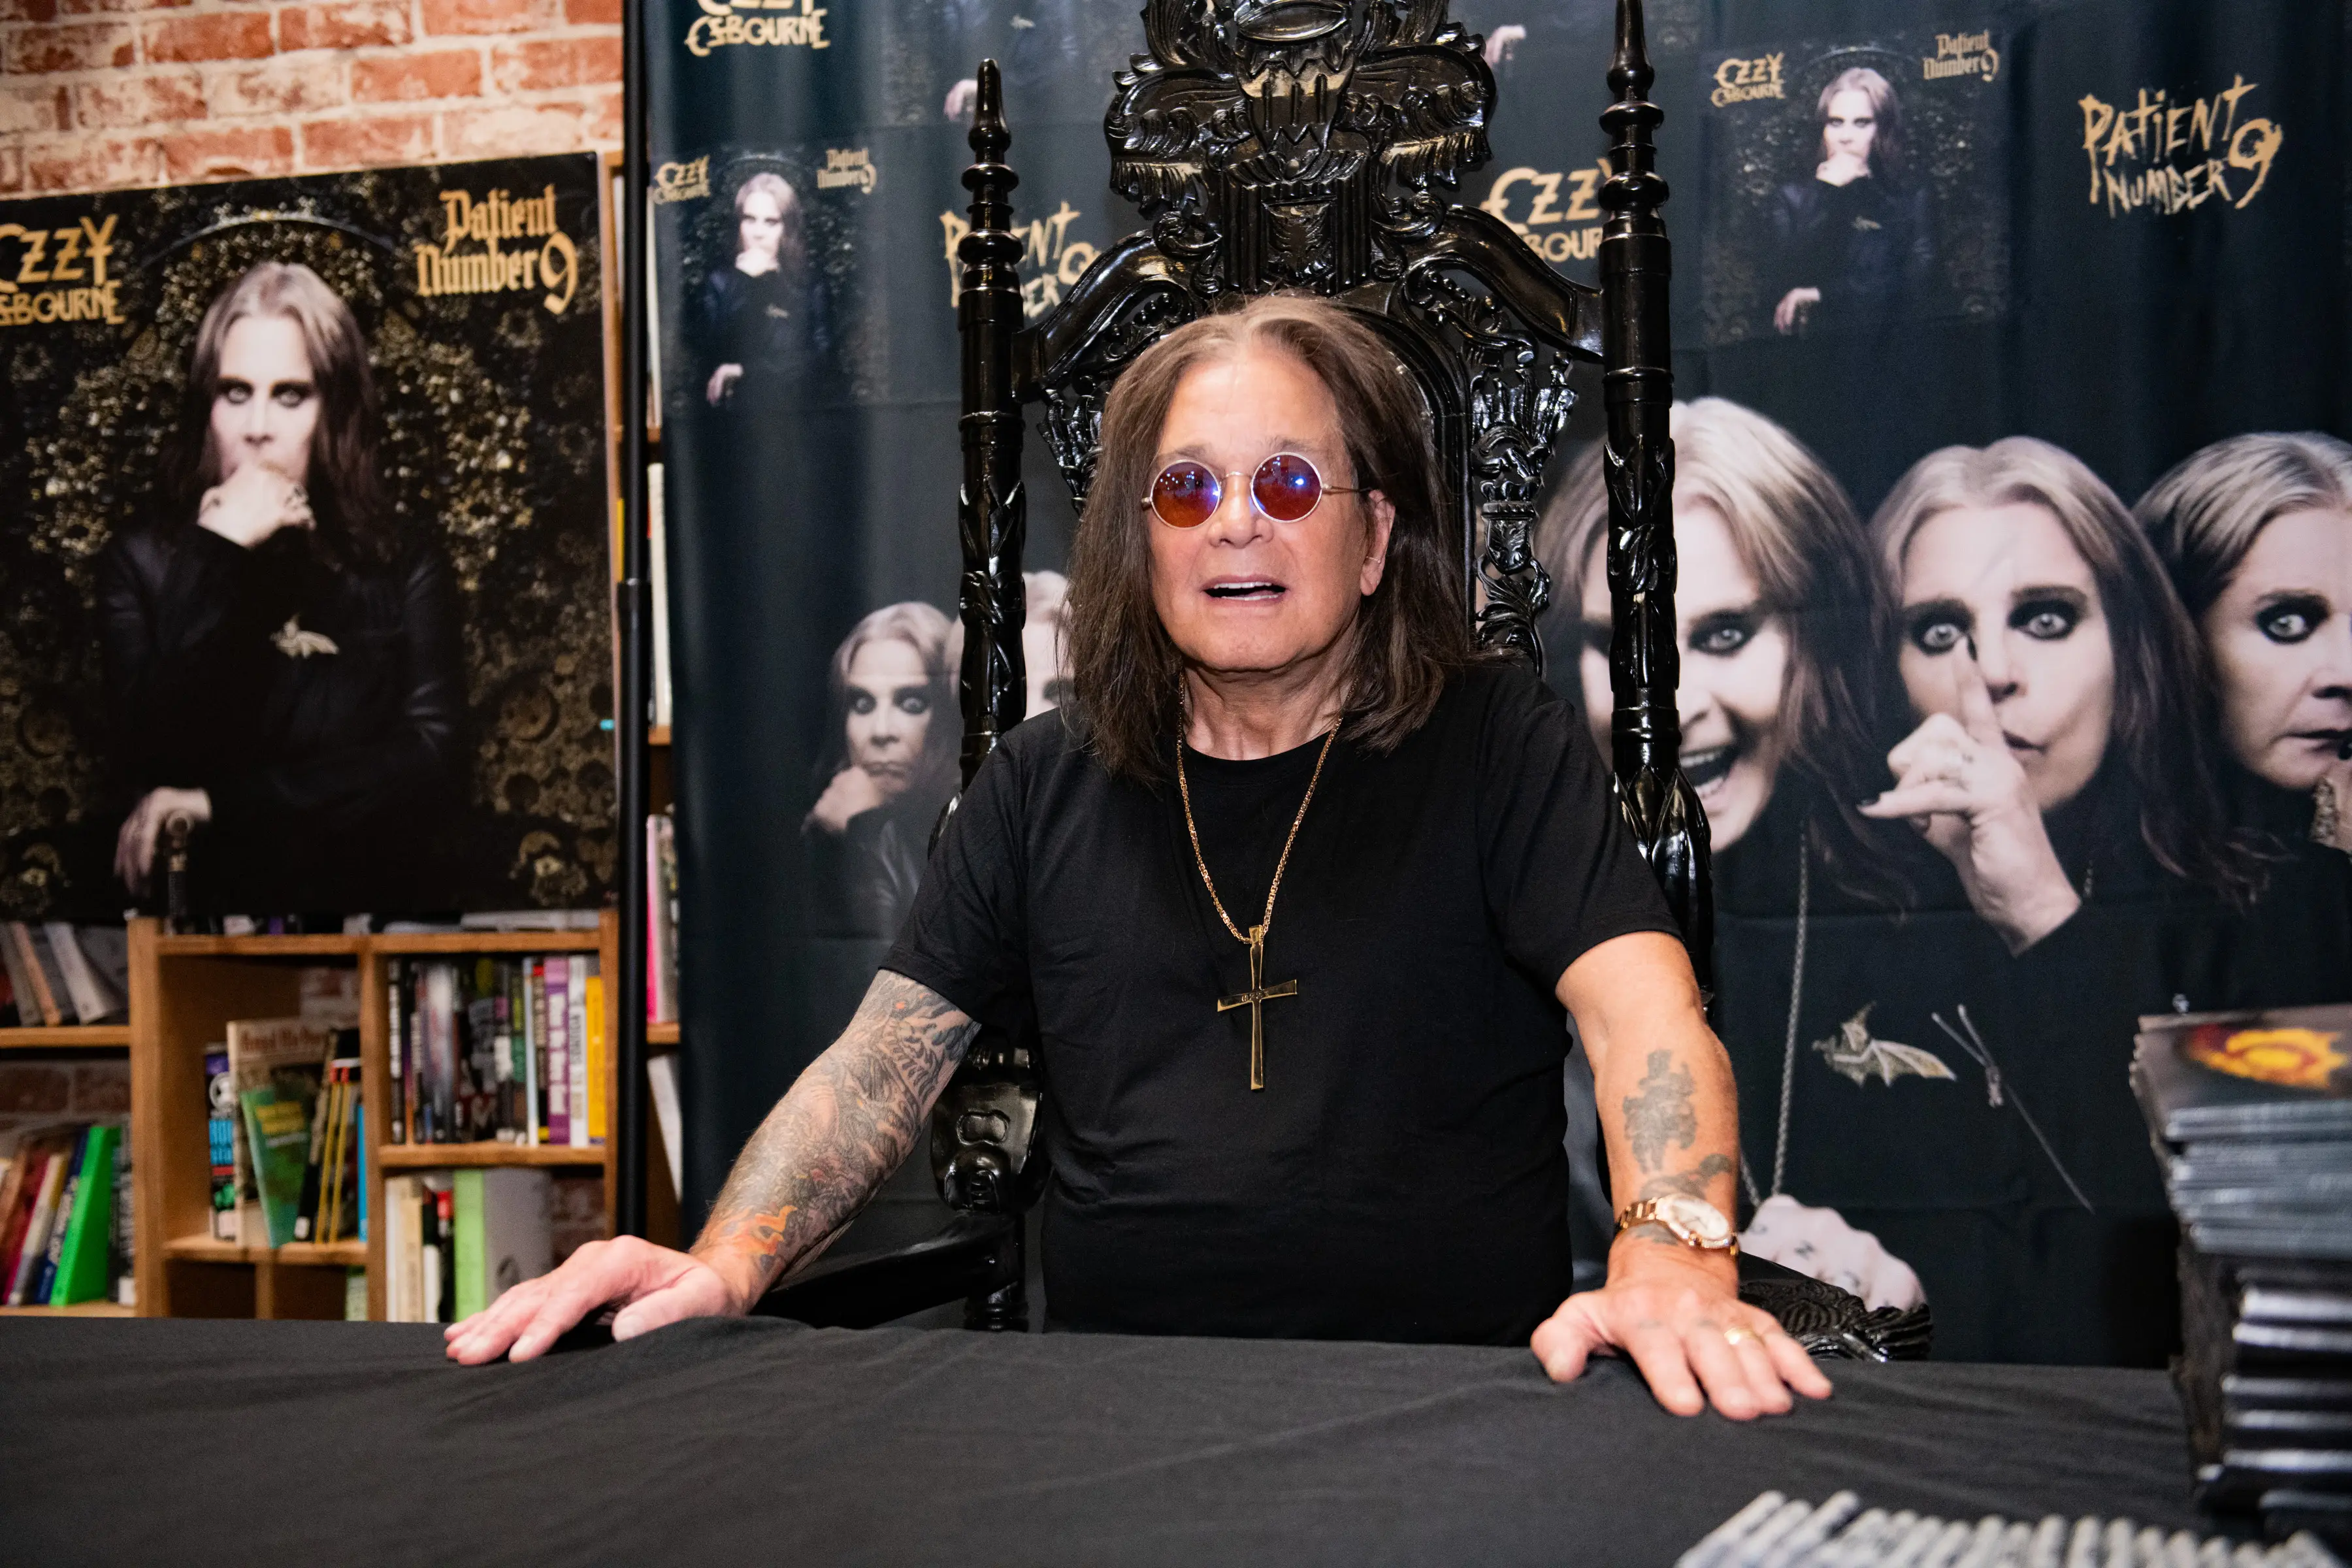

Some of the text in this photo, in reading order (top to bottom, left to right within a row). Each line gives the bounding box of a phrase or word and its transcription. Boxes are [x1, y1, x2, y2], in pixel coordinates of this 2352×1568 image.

[684, 8, 831, 57] OSBOURNE
[1713, 52, 1784, 90] OZZY
[2103, 118, 2283, 219] NUMBER 9
[439, 183, 557, 256] Patient
[0, 280, 127, 325] SBOURNE
[413, 231, 578, 321] Number 9
